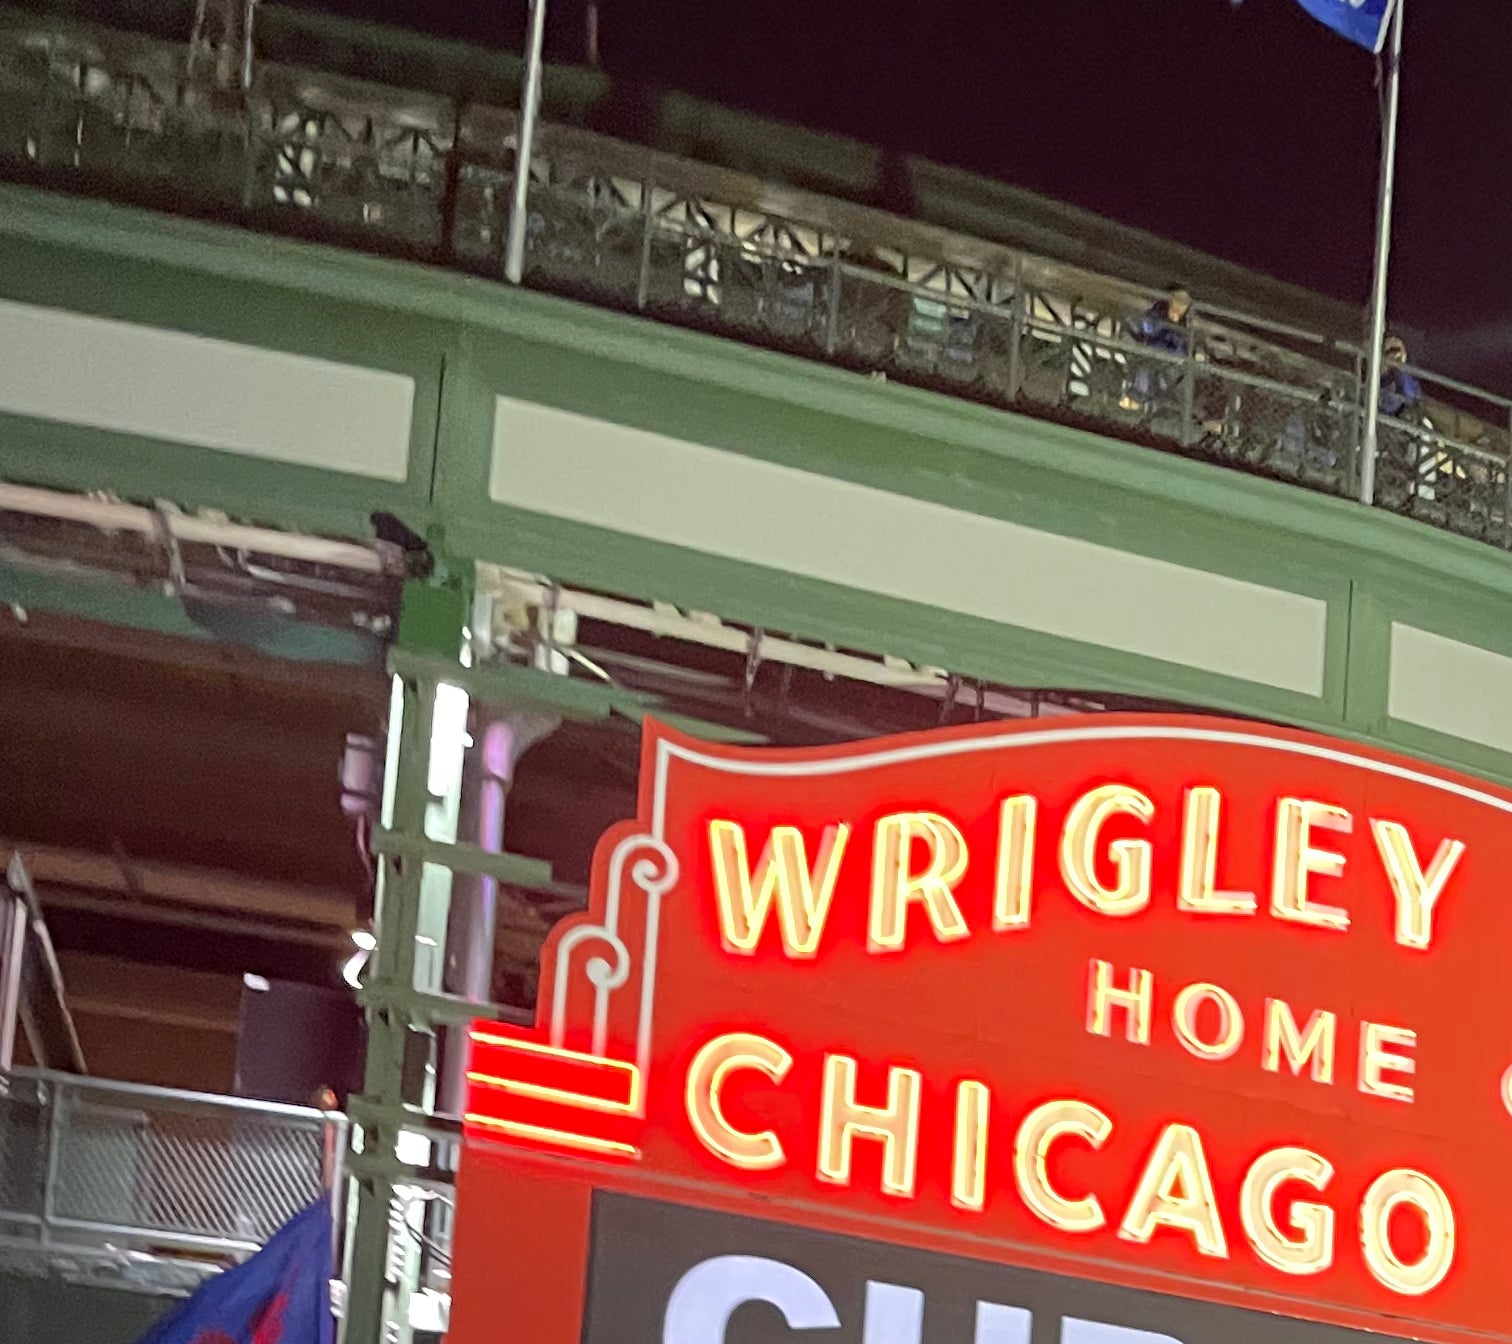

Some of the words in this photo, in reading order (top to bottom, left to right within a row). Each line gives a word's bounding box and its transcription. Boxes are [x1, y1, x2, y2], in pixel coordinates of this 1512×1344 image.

[709, 784, 1466, 957] WRIGLEY
[1087, 957, 1418, 1103] HOME
[685, 1032, 1456, 1297] CHICAGO
